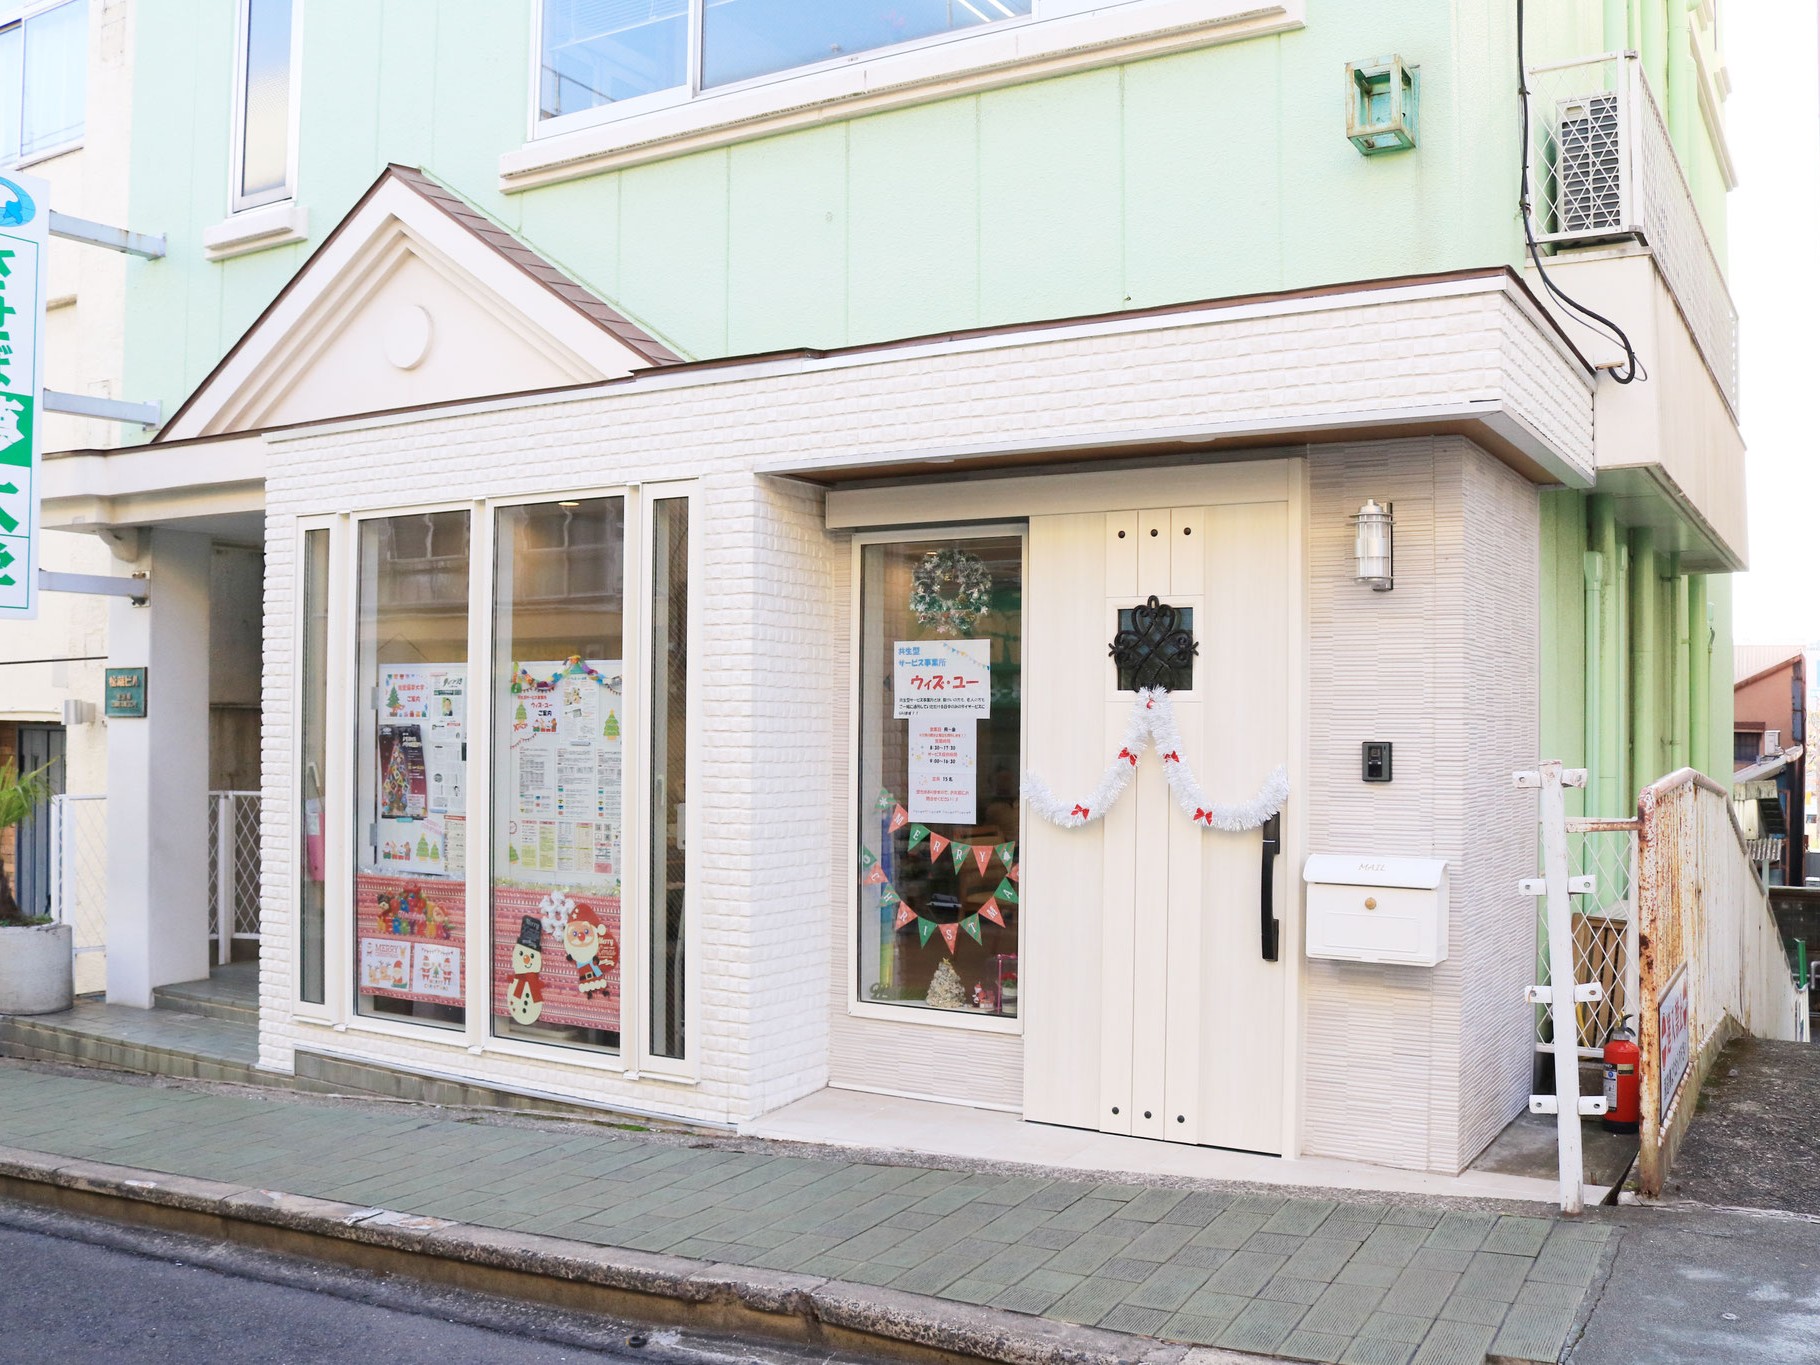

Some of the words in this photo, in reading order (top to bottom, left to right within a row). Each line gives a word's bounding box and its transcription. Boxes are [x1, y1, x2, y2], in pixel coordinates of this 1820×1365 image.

[898, 647, 920, 655] 共生型
[898, 658, 946, 667] サービス事業所
[910, 675, 979, 690] ウィズ・ユー
[1359, 863, 1385, 871] MAIL
